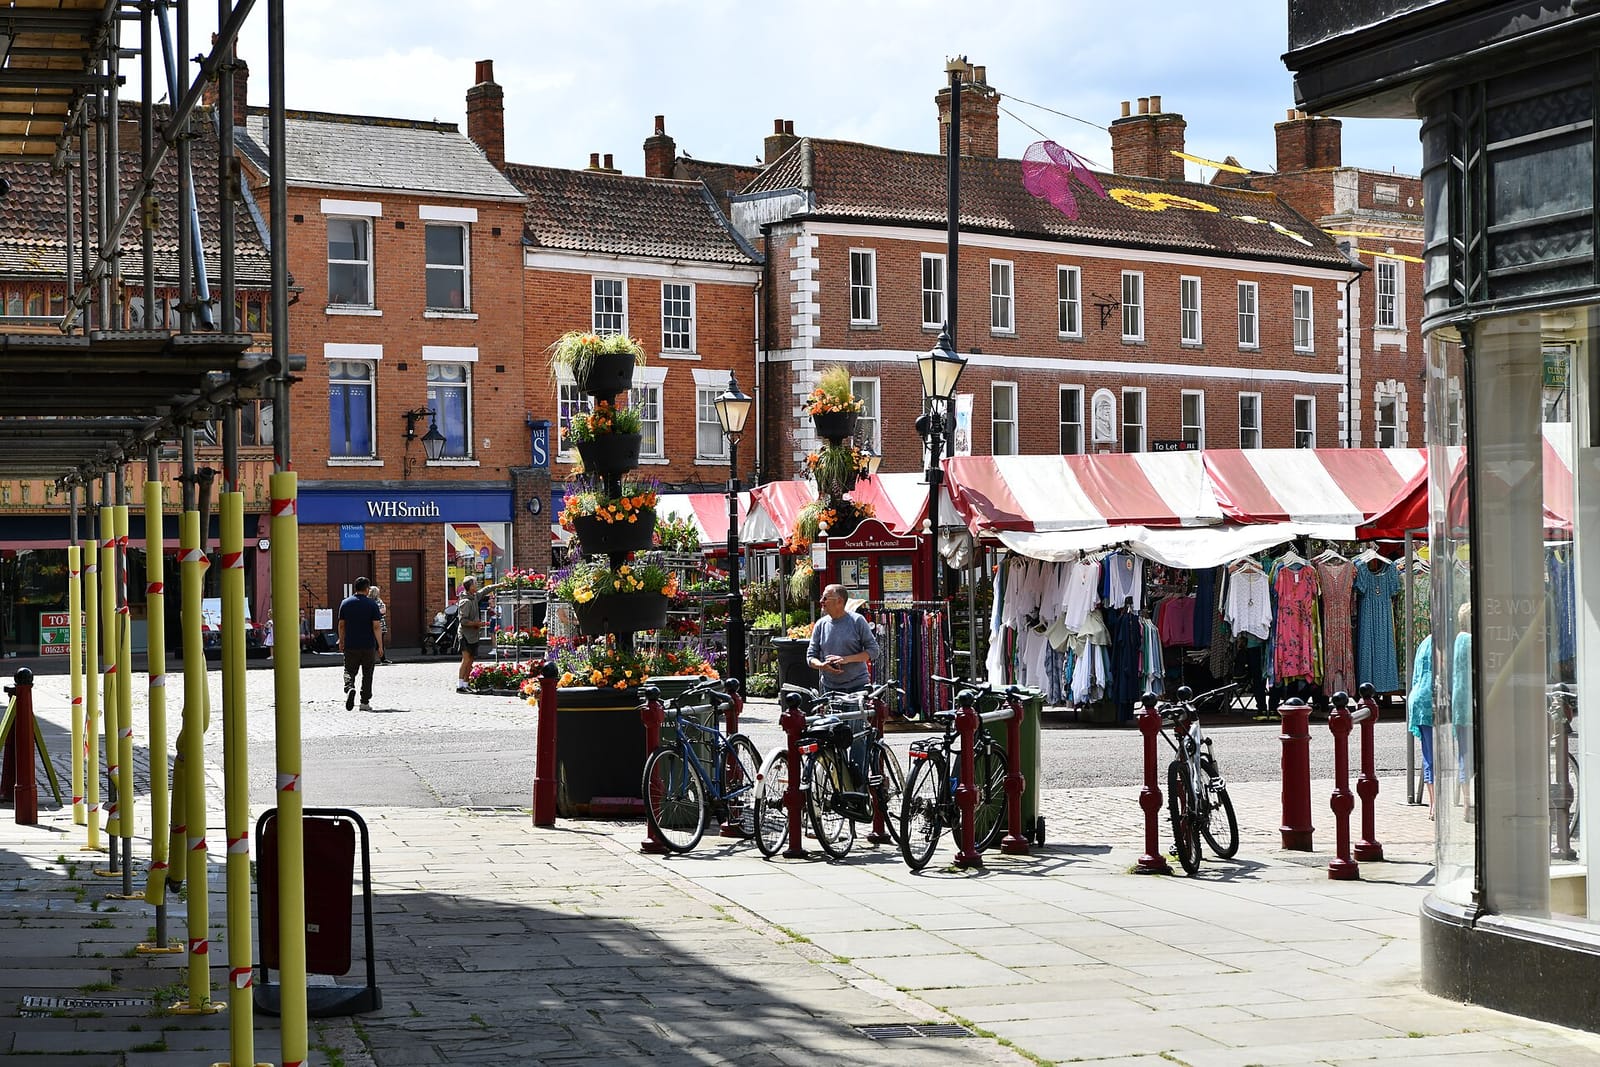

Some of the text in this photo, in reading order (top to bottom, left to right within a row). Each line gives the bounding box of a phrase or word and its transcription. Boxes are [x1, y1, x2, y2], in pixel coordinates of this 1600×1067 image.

[533, 429, 545, 437] WH
[533, 437, 547, 465] S
[1154, 442, 1165, 450] To
[1165, 442, 1178, 450] Let
[366, 500, 441, 518] WHSmith
[49, 615, 63, 625] TO
